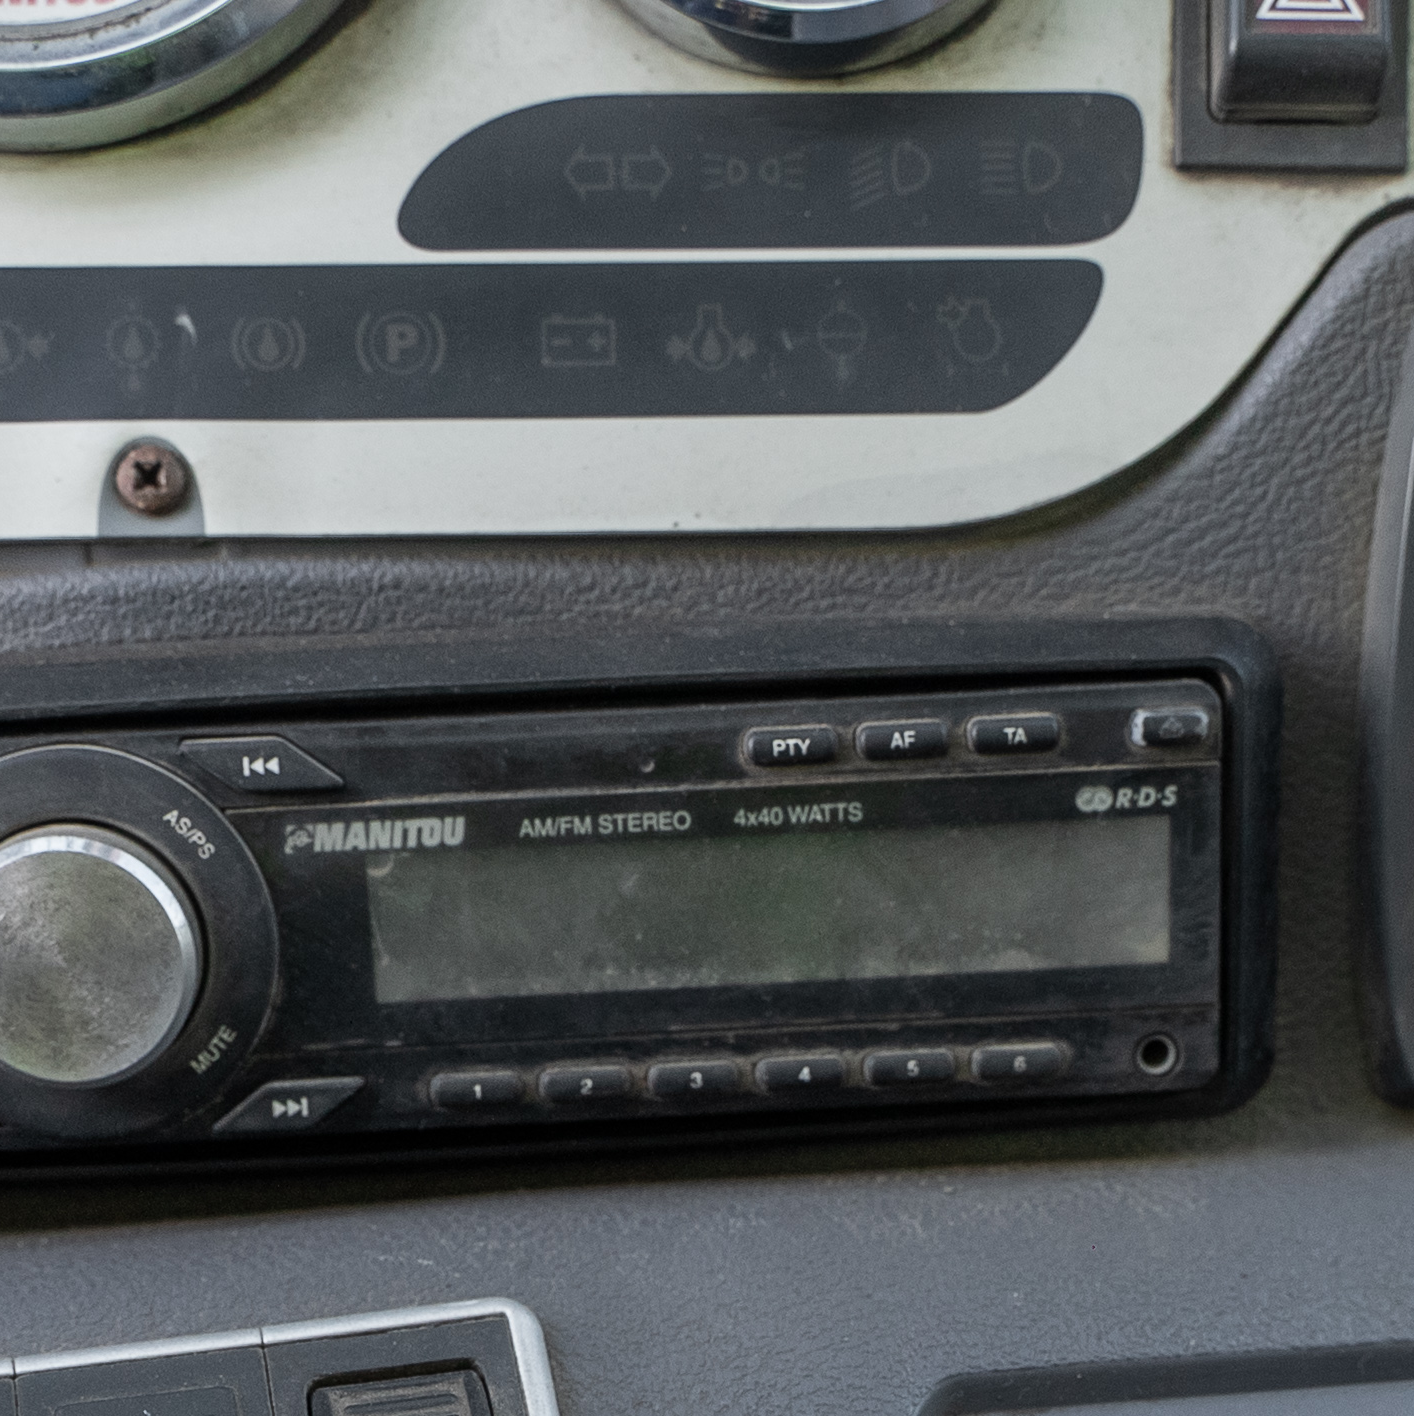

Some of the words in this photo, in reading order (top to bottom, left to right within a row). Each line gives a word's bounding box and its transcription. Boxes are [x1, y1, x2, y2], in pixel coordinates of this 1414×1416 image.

[890, 730, 917, 749] AF
[1003, 727, 1028, 744] TA
[772, 738, 811, 757] PTY
[519, 815, 592, 838] AM/FM
[597, 810, 692, 834] STEREO
[733, 806, 784, 827] 4x40
[787, 802, 864, 824] WATTS
[162, 808, 217, 861] AS/PS
[313, 816, 466, 853] MANITOU
[190, 1024, 238, 1075] MUTE
[798, 1066, 812, 1083] 4
[907, 1060, 920, 1077] 5
[580, 1079, 593, 1096] 2
[690, 1072, 703, 1089] 3
[472, 1084, 483, 1100] 1
